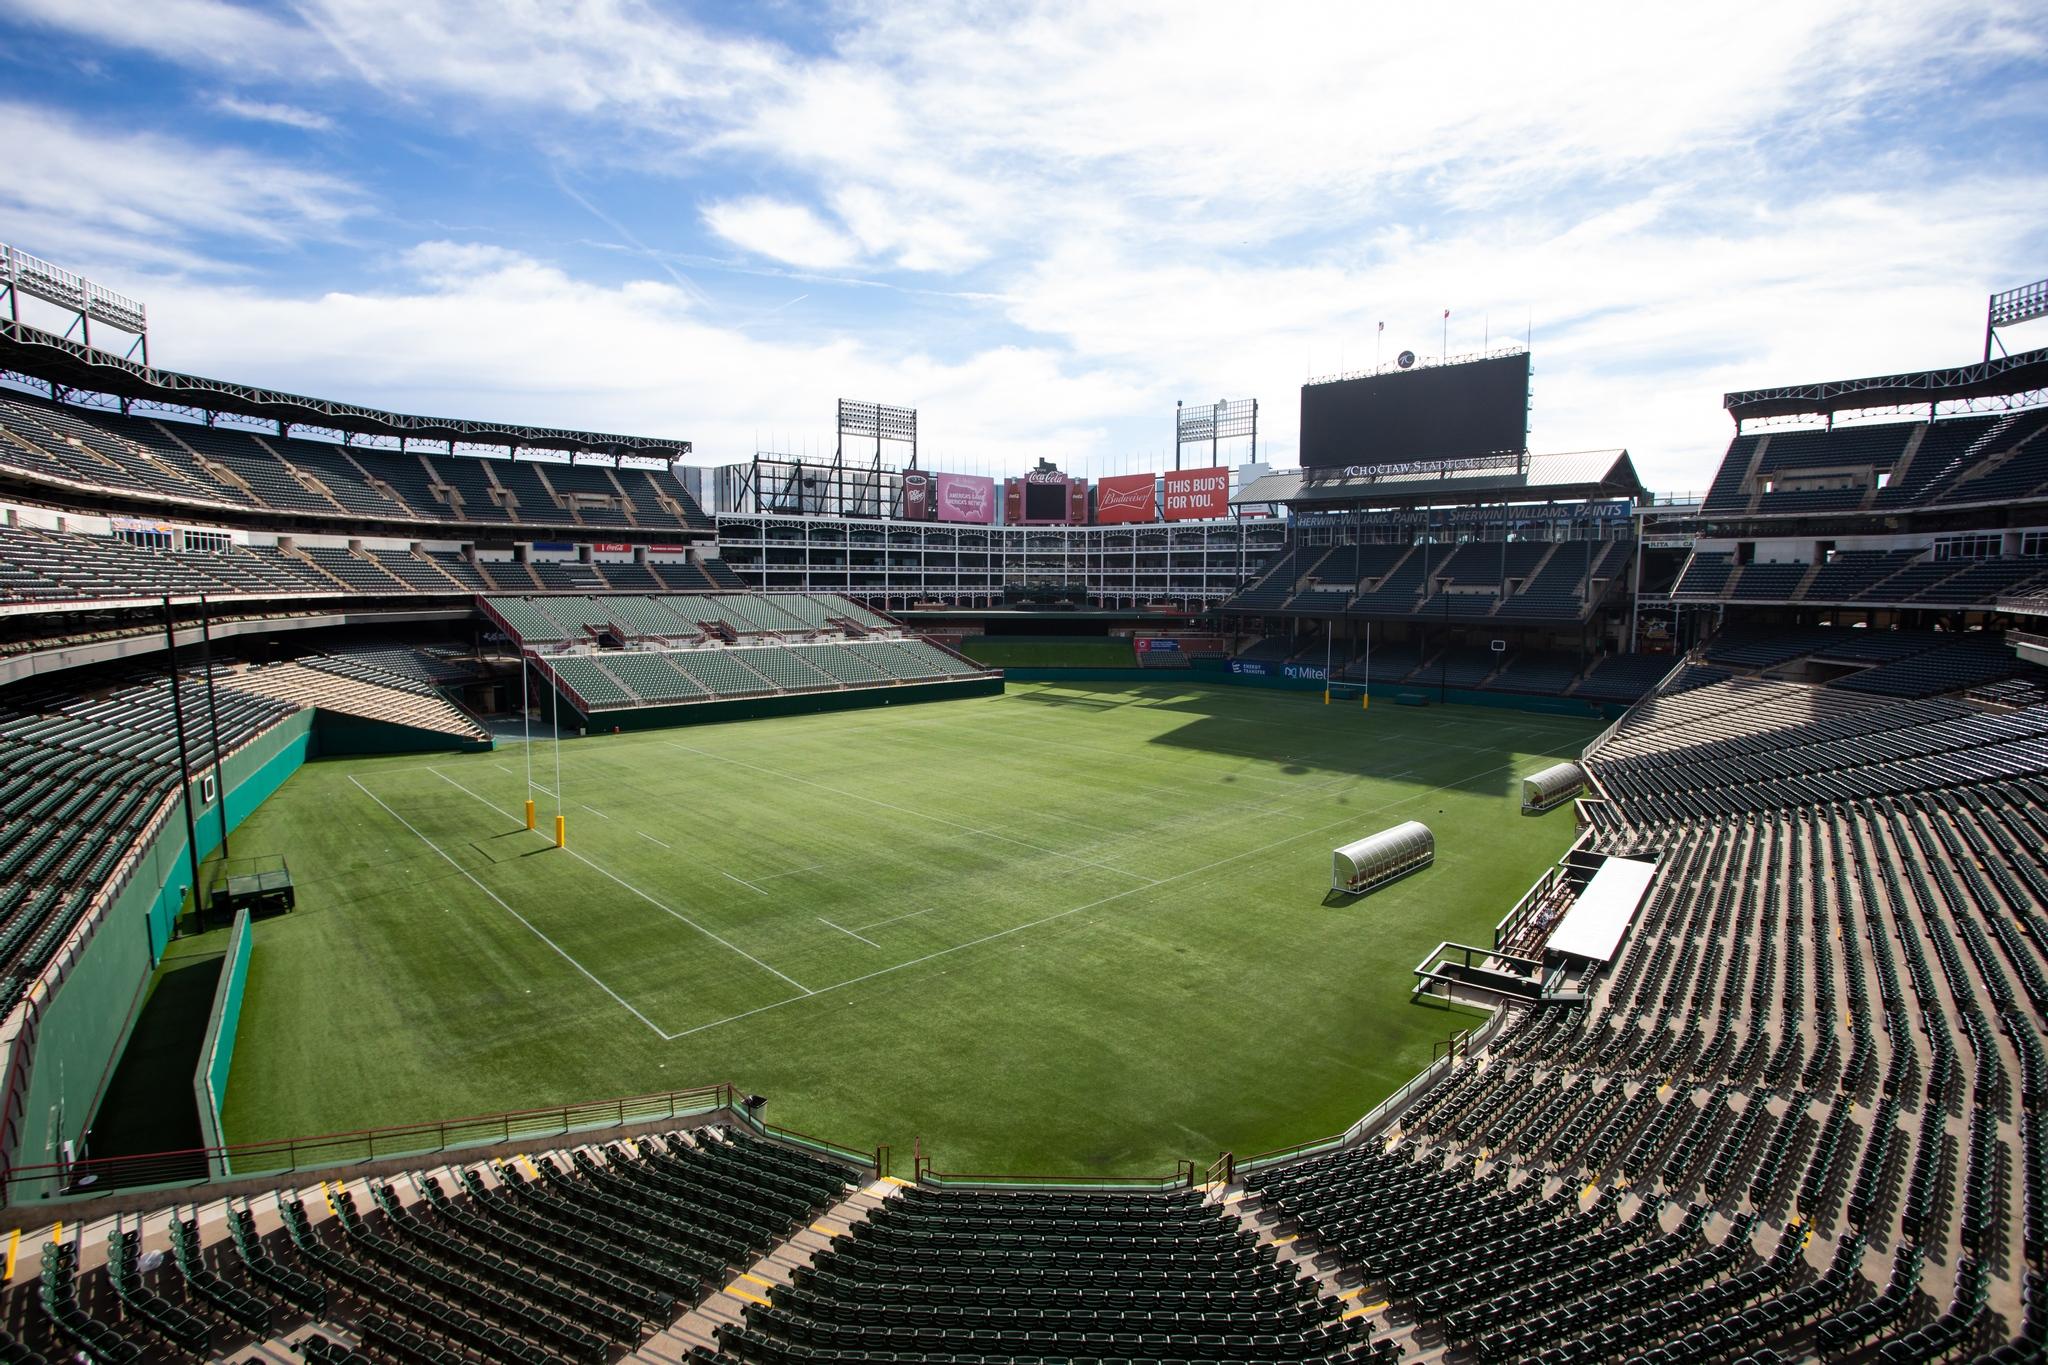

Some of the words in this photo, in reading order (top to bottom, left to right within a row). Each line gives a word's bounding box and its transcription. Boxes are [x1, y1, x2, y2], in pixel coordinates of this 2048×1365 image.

[1350, 463, 1410, 476] CHOCTAW
[1413, 459, 1474, 471] STADIUM
[1167, 479, 1190, 493] THIS
[1193, 477, 1225, 492] BUD'S
[1105, 492, 1149, 505] Budweiser
[1167, 496, 1187, 509] FOR
[1190, 494, 1214, 508] YOU.
[1574, 504, 1622, 517] PAINTS
[1299, 666, 1327, 680] Mitel
